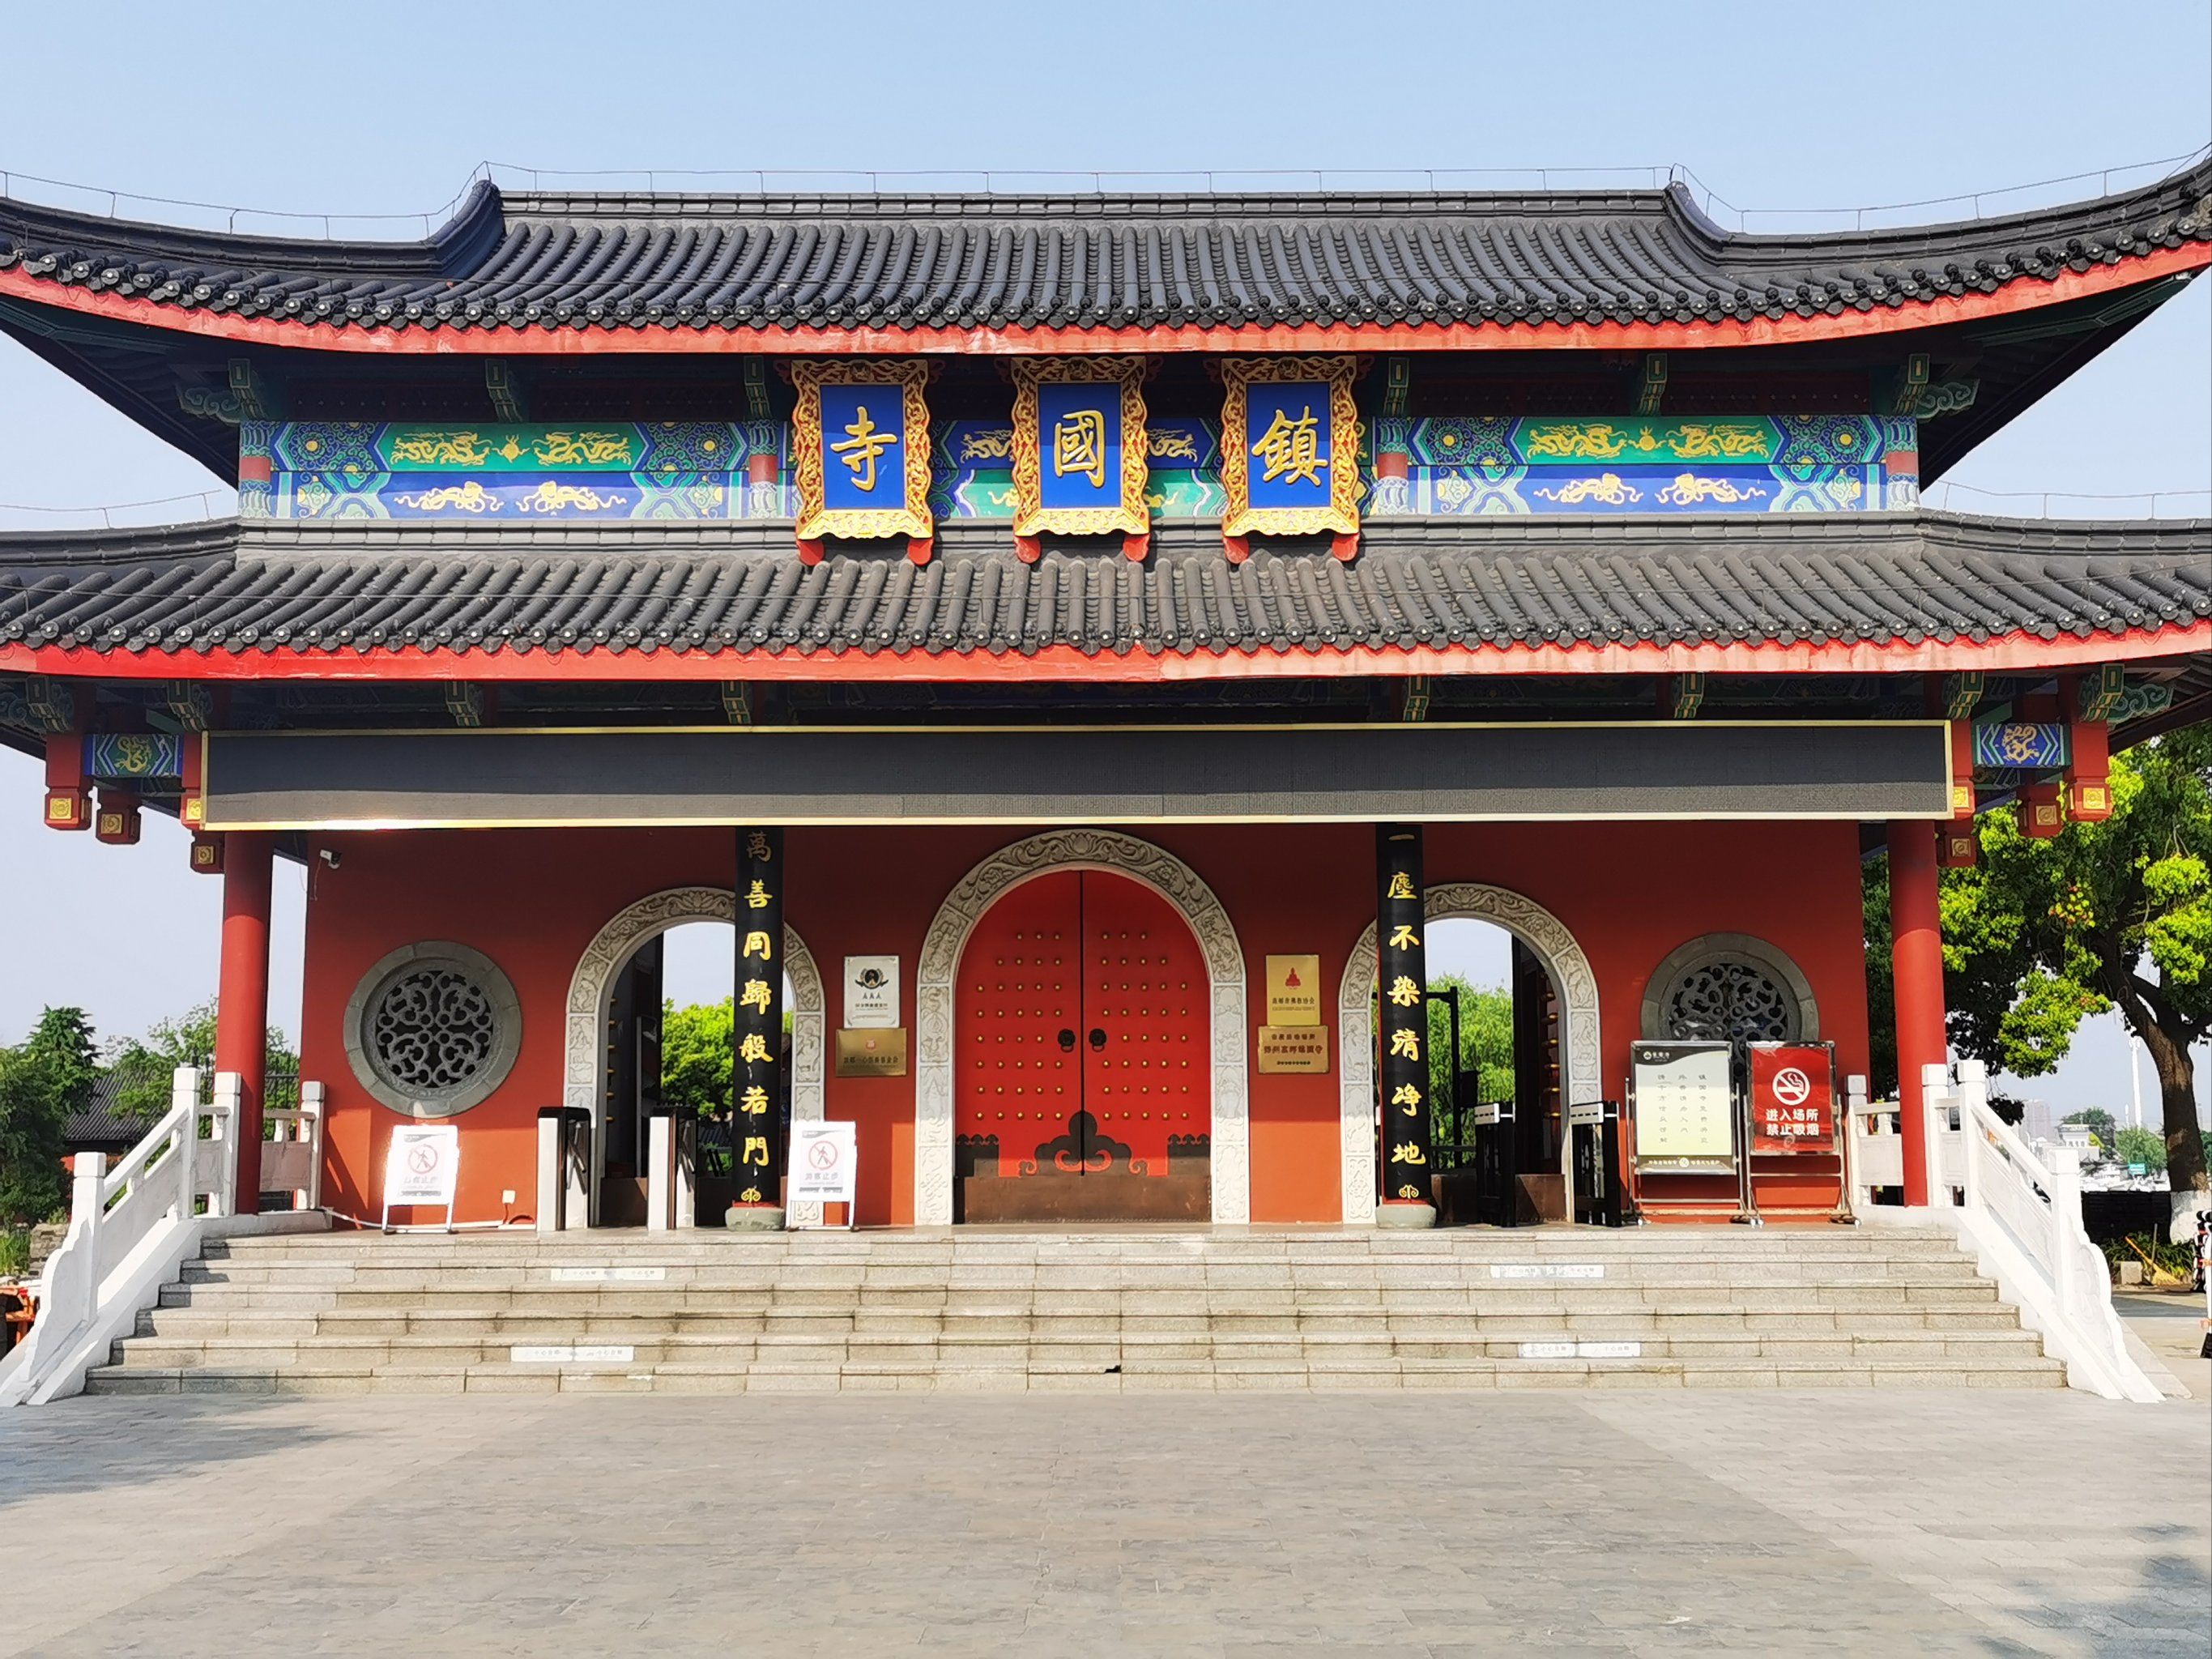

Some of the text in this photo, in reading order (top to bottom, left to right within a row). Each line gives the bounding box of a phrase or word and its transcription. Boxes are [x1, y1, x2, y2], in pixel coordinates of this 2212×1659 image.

[829, 406, 898, 492] 寺
[1053, 409, 1106, 488] 國
[1251, 406, 1329, 487] 鎮
[739, 831, 774, 1167] 萬善同歸般若門
[1766, 1108, 1818, 1121] 进入场所
[1767, 1123, 1819, 1137] 禁止吸烟
